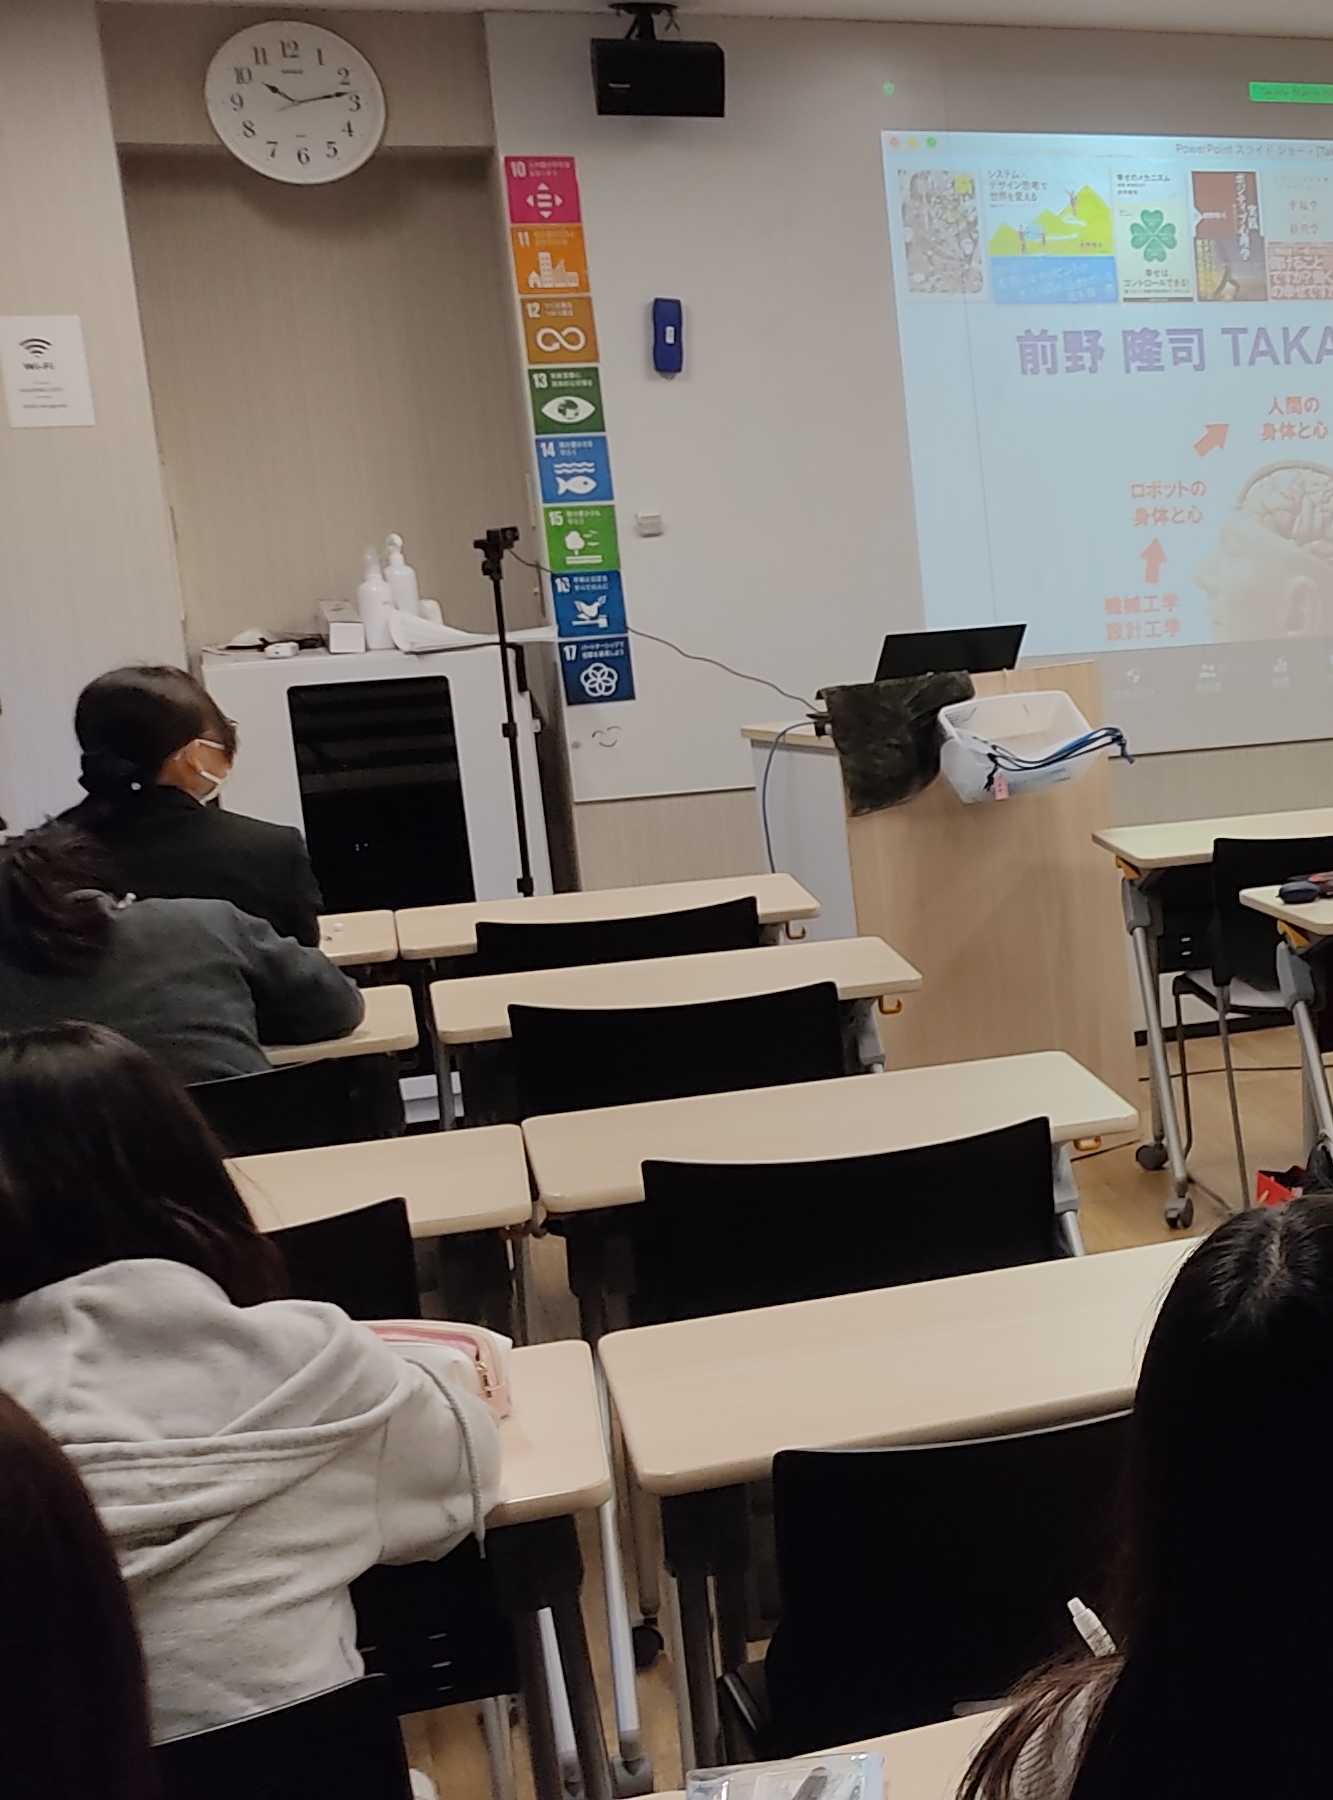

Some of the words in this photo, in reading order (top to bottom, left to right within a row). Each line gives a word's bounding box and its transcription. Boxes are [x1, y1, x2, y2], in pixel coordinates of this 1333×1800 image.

[254, 47, 268, 65] 11
[280, 40, 299, 58] 12
[317, 48, 324, 66] 1
[234, 67, 252, 85] 10
[337, 67, 350, 85] 2
[230, 93, 243, 111] 9
[349, 94, 361, 112] 3
[242, 120, 256, 138] 8
[342, 121, 353, 137] 4
[266, 141, 278, 158] 7
[297, 148, 310, 165] 6
[326, 141, 338, 158] 5
[510, 161, 527, 178] 10
[517, 231, 530, 248] 11
[527, 302, 541, 318] 12
[1016, 328, 1104, 376] 前野
[1122, 327, 1206, 374] 隆司
[533, 373, 548, 388] 13
[1268, 396, 1320, 416] 人間の
[1261, 421, 1328, 441] 身体と心
[540, 442, 556, 458] 14
[1130, 481, 1207, 499] ロボットの
[549, 511, 564, 526] 15
[1133, 506, 1203, 526] 身体と心
[564, 645, 577, 661] 17
